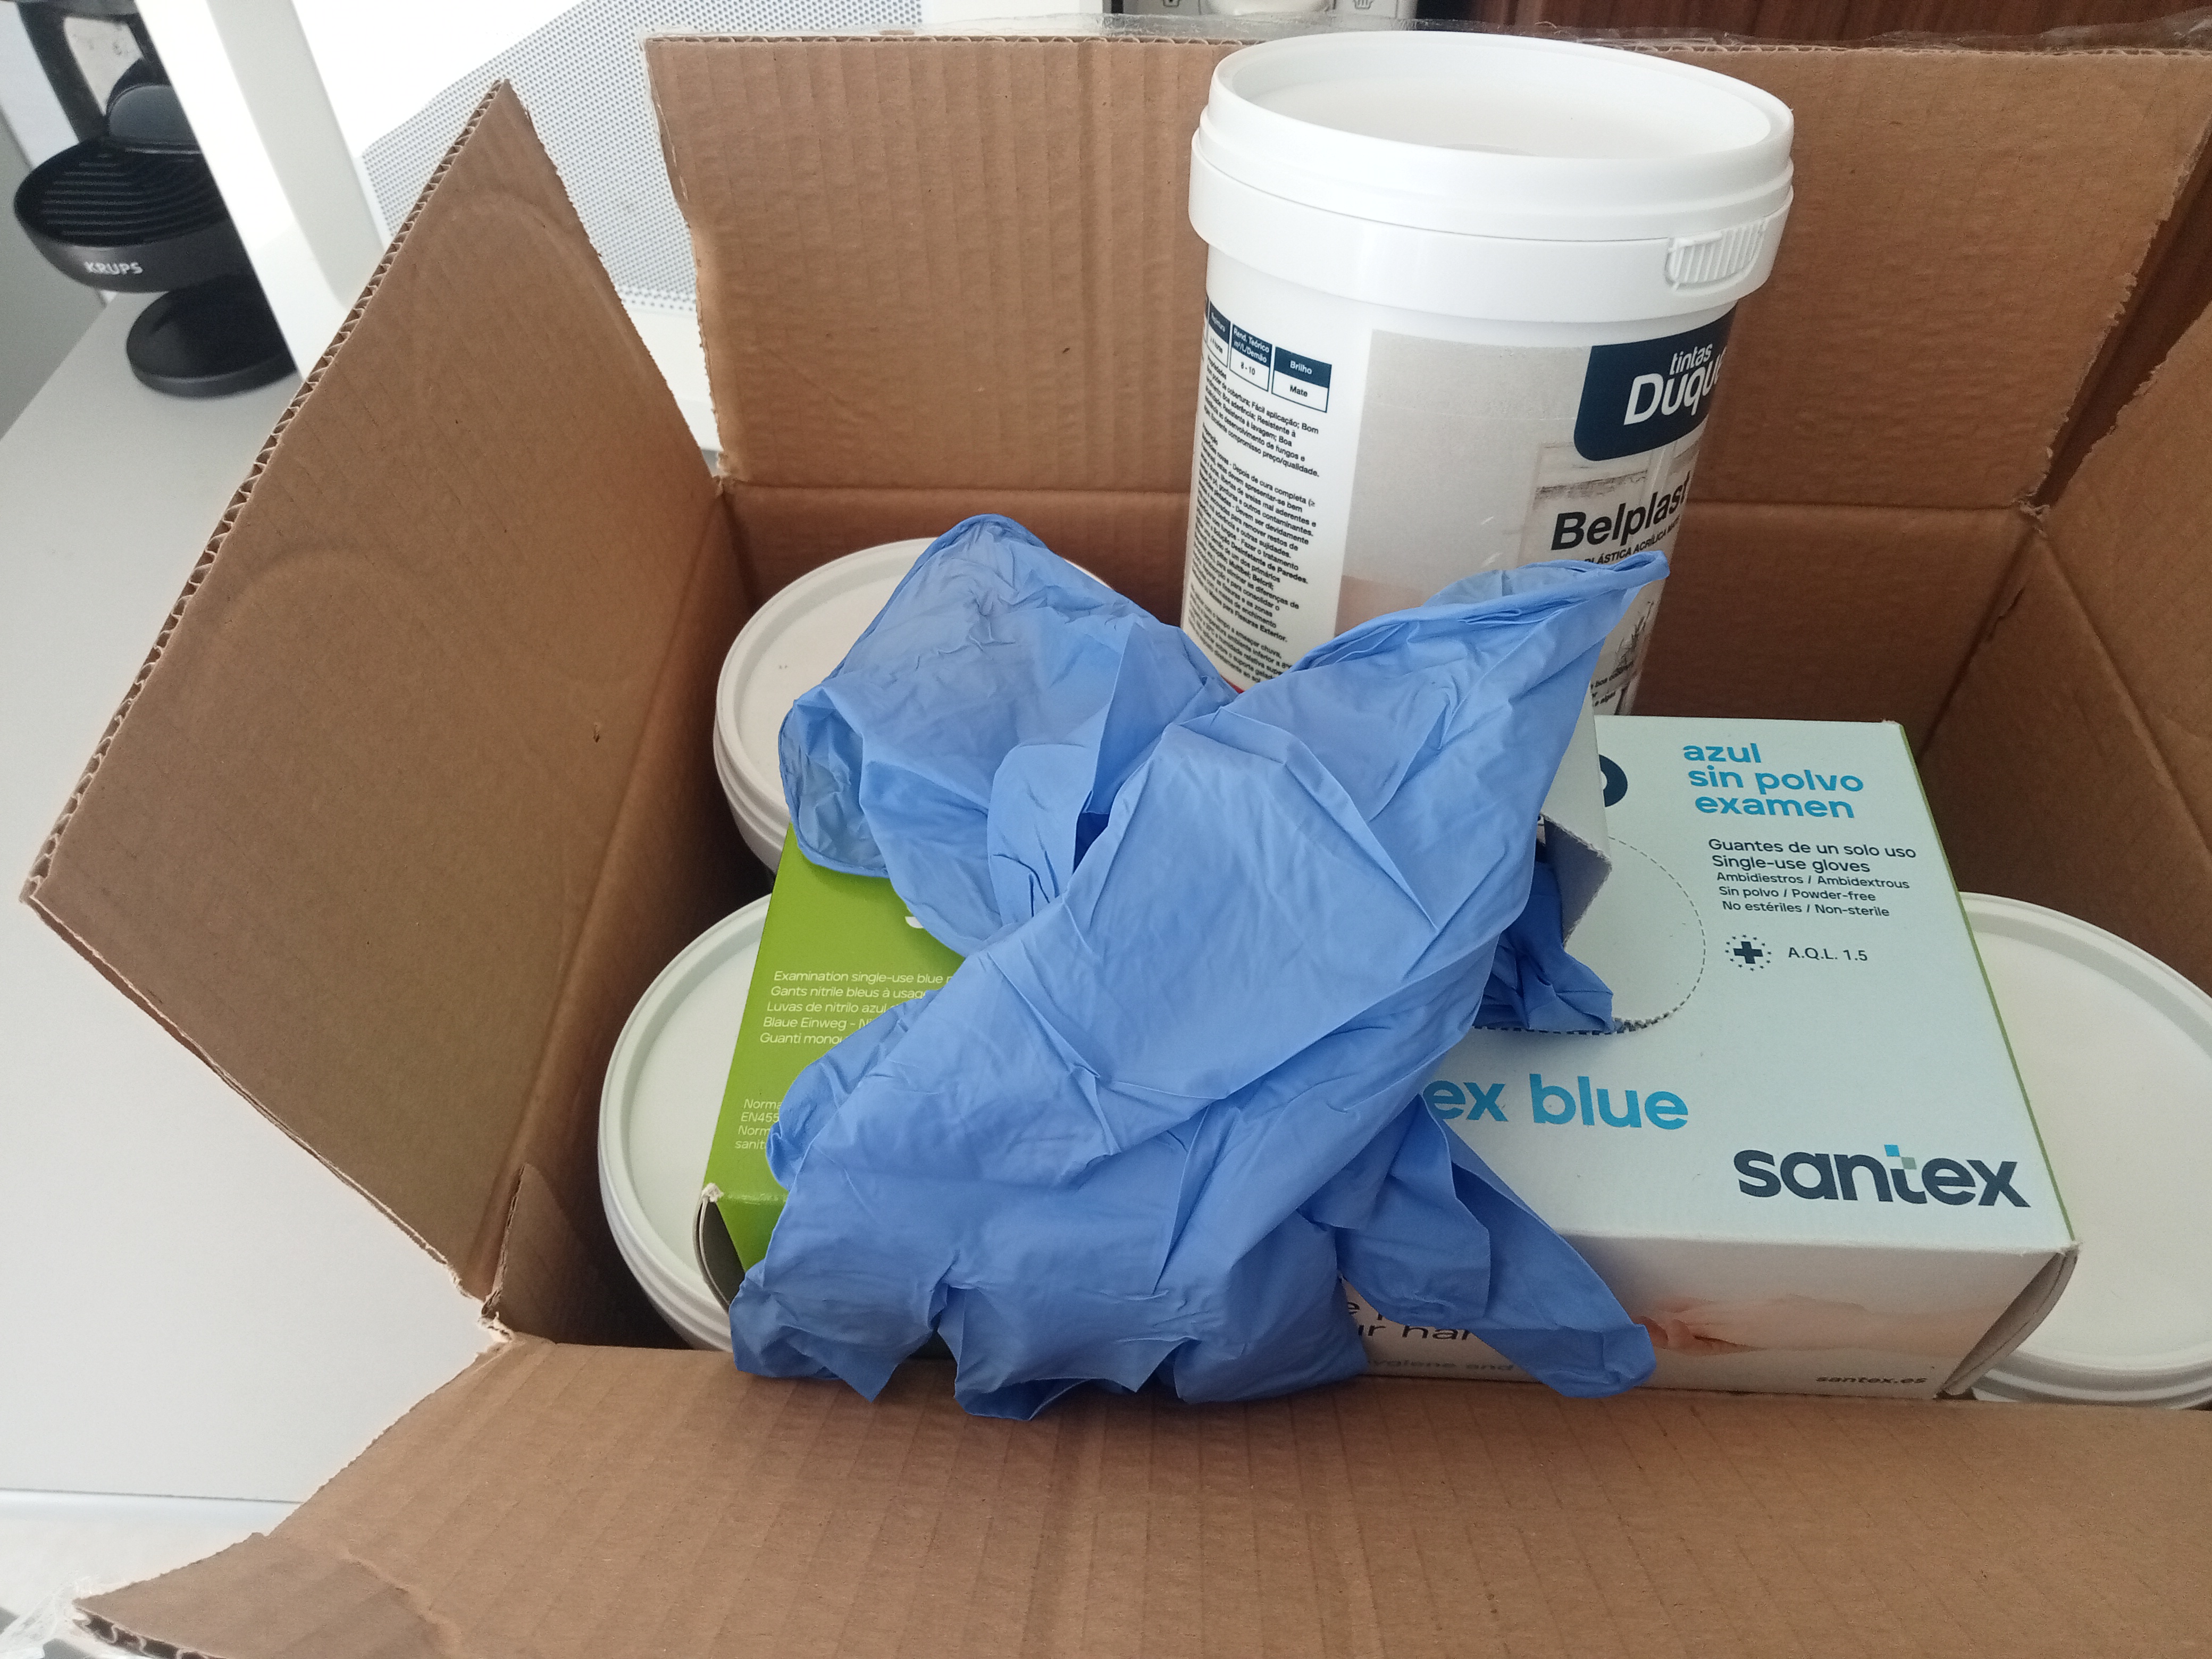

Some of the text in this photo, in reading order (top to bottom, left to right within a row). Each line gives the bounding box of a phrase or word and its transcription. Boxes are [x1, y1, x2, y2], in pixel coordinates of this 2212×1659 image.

[84, 261, 143, 275] KRUPS
[1249, 336, 1269, 353] Teórico
[1290, 360, 1312, 374] Brilho
[1669, 343, 1713, 375] tintas
[1249, 366, 1255, 375] 10
[1290, 384, 1308, 397] Mate
[1252, 401, 1265, 414] Fácil
[1266, 410, 1300, 429] aplicação;
[1302, 423, 1319, 434] Bom
[1257, 415, 1289, 435] Resistente
[1279, 435, 1292, 447] Boa
[1228, 431, 1261, 454] compromisso
[1262, 451, 1319, 477] preço/qualidade.
[1276, 445, 1298, 459] fungos
[1233, 463, 1250, 479] Depois
[1260, 481, 1273, 491] cura
[1275, 488, 1306, 504] completa
[1245, 482, 1285, 506] apresentar-se
[1287, 501, 1302, 513] bem
[1243, 502, 1261, 515] outros
[1262, 513, 1313, 537] contaminantes.
[1262, 502, 1274, 512] mal
[1275, 508, 1310, 525] aderentes
[1551, 470, 1691, 550] Belplast
[1243, 522, 1266, 537] remover
[1267, 534, 1287, 547] restos
[1265, 523, 1309, 545] devidamente
[1263, 551, 1298, 571] tratamento
[1277, 566, 1308, 584] Paredes.
[1255, 586, 1288, 605] diferenças
[1683, 742, 1762, 763] azul
[1689, 765, 1864, 795] sin polvo
[1695, 796, 1855, 818] examen
[1708, 839, 1916, 858] Guantes de un solo uso
[1712, 854, 1871, 873] Single-use gloves
[1717, 872, 1804, 884] Ambidiestros
[1817, 875, 1910, 889] Ambidextrous
[1719, 886, 1739, 896] Sin
[1743, 887, 1779, 899] polvo
[1792, 889, 1876, 901] Powder-free
[1722, 901, 1741, 910] No
[1745, 901, 1802, 913] estériles
[1814, 904, 1890, 916] Non-sterile
[1788, 947, 1868, 961] A.Q.L. 1.5
[774, 971, 848, 982] Examination
[851, 971, 914, 984] single-use
[917, 973, 943, 984] blue
[771, 986, 807, 997] Gants
[810, 986, 844, 998] nitrile
[847, 987, 879, 998] bleus
[883, 987, 890, 998] à
[767, 1001, 887, 1013] Luvas de nitrilo azul
[763, 1017, 798, 1028] Blaue
[801, 1018, 847, 1031] Einweg
[760, 1033, 801, 1044] Guanti
[1422, 1073, 1688, 1130] ex blue
[741, 1112, 779, 1122] EN455
[735, 1139, 766, 1150] sanit
[1733, 1144, 2031, 1208] santex
